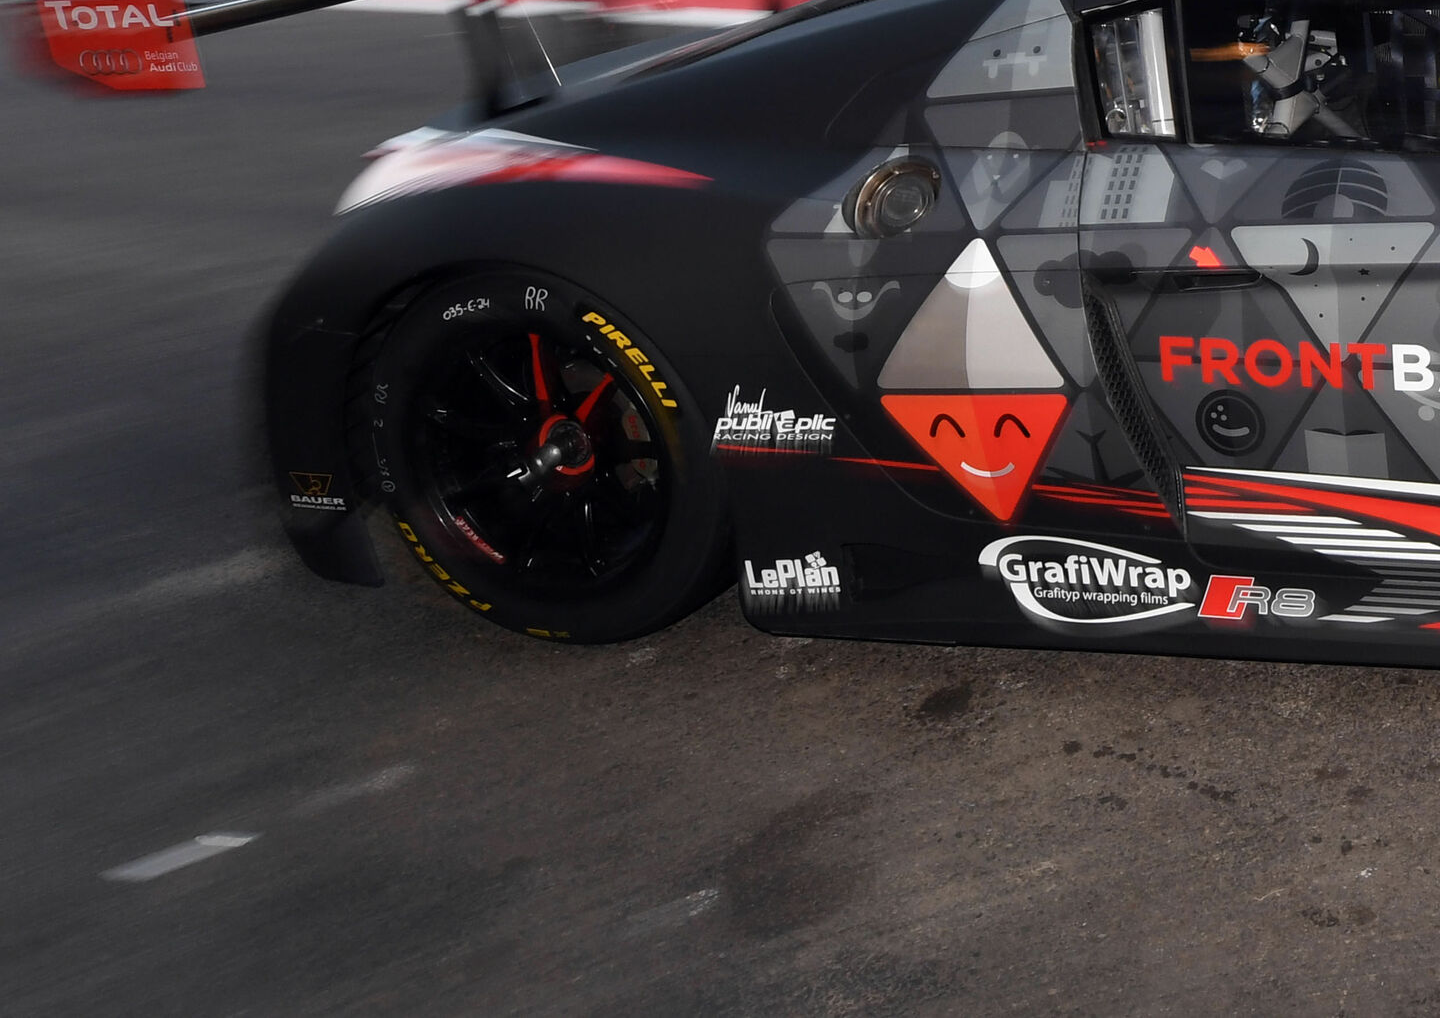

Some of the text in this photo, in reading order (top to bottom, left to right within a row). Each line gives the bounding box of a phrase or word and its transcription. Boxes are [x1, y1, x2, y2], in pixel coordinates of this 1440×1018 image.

[44, 0, 174, 30] TOTAL
[144, 50, 179, 62] Belgian
[149, 62, 198, 72] Audi Club
[524, 286, 549, 311] RR
[582, 311, 678, 409] PIRELLI
[776, 433, 833, 441] DESIGN
[290, 494, 346, 507] BAUER
[744, 559, 840, 588] LePlan
[999, 553, 1192, 598] GrafiWrap
[807, 586, 841, 594] WINES
[1033, 586, 1169, 606] Grafityp wrapping films
[1226, 585, 1316, 618] R8
